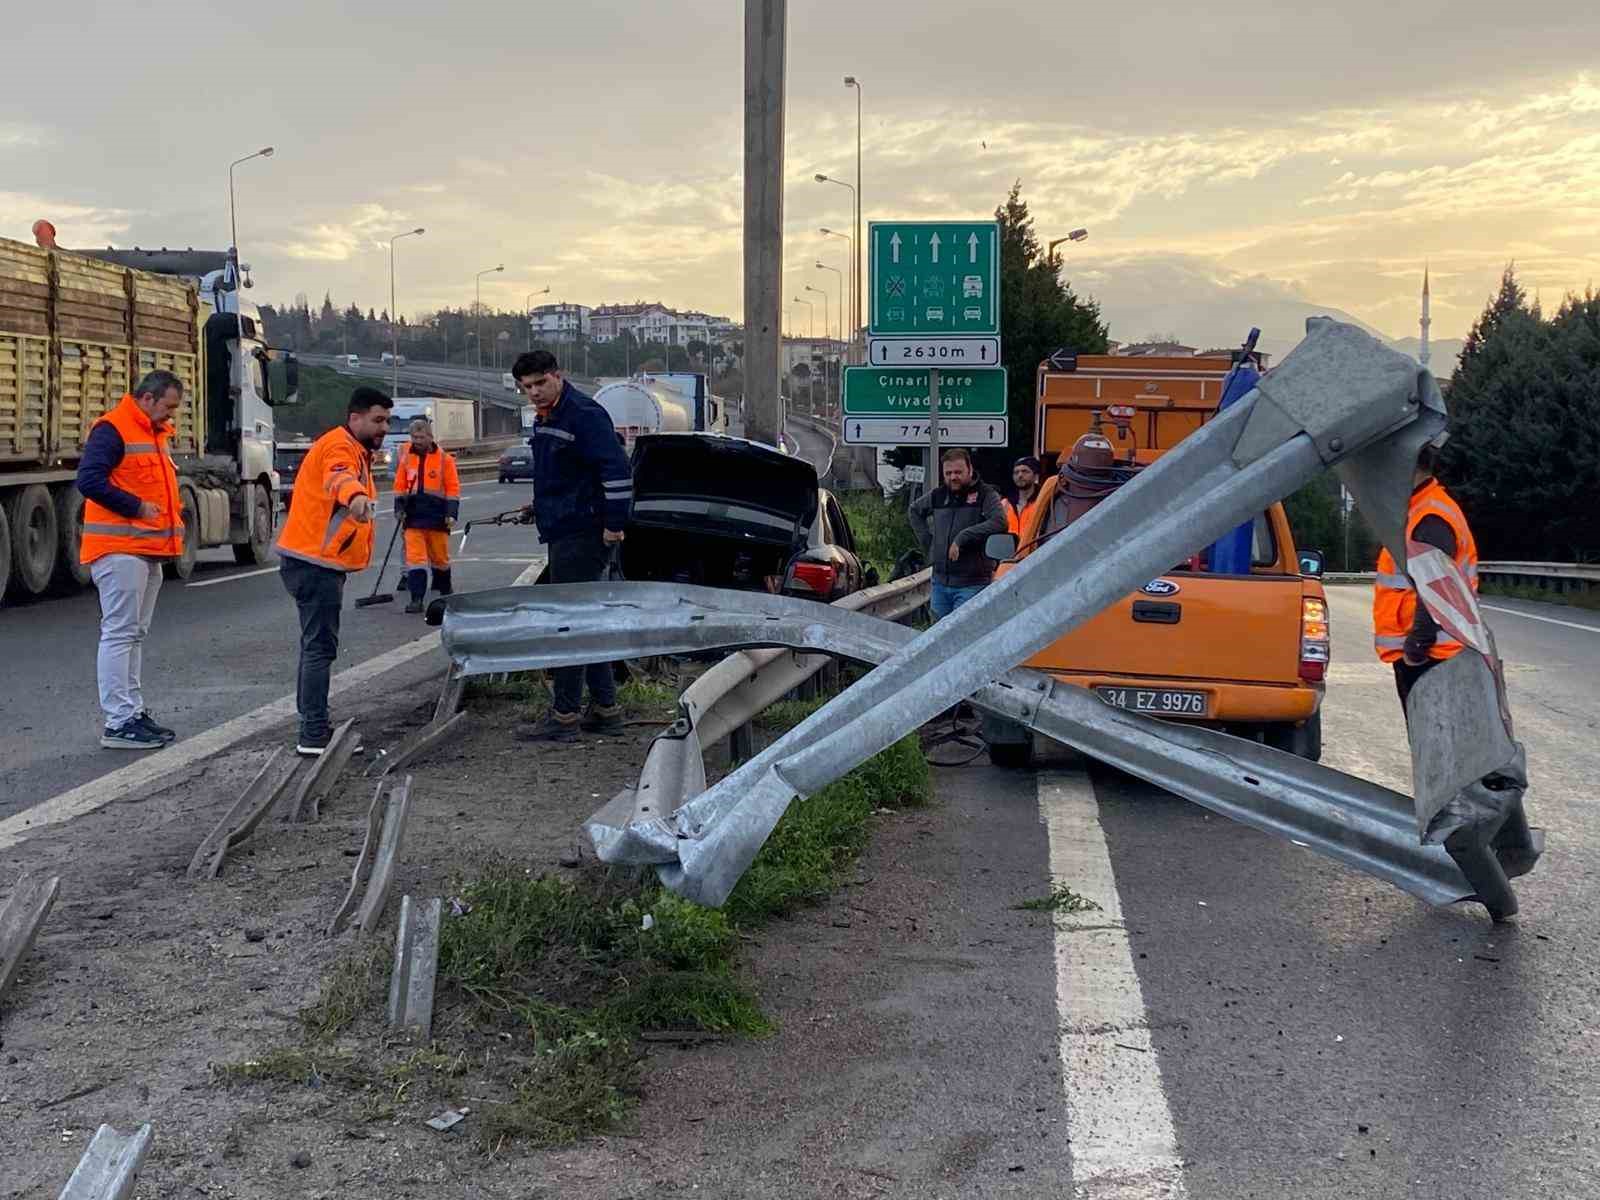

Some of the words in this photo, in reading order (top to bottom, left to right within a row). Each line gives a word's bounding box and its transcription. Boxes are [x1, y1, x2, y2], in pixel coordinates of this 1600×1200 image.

[903, 347, 965, 358] 2630m
[879, 375, 972, 387] Çınarldere
[887, 394, 964, 410] Viyadğü
[1145, 581, 1170, 592] Ford
[1107, 690, 1127, 708] 34
[1136, 692, 1157, 709] EZ
[1161, 693, 1203, 712] 9976
